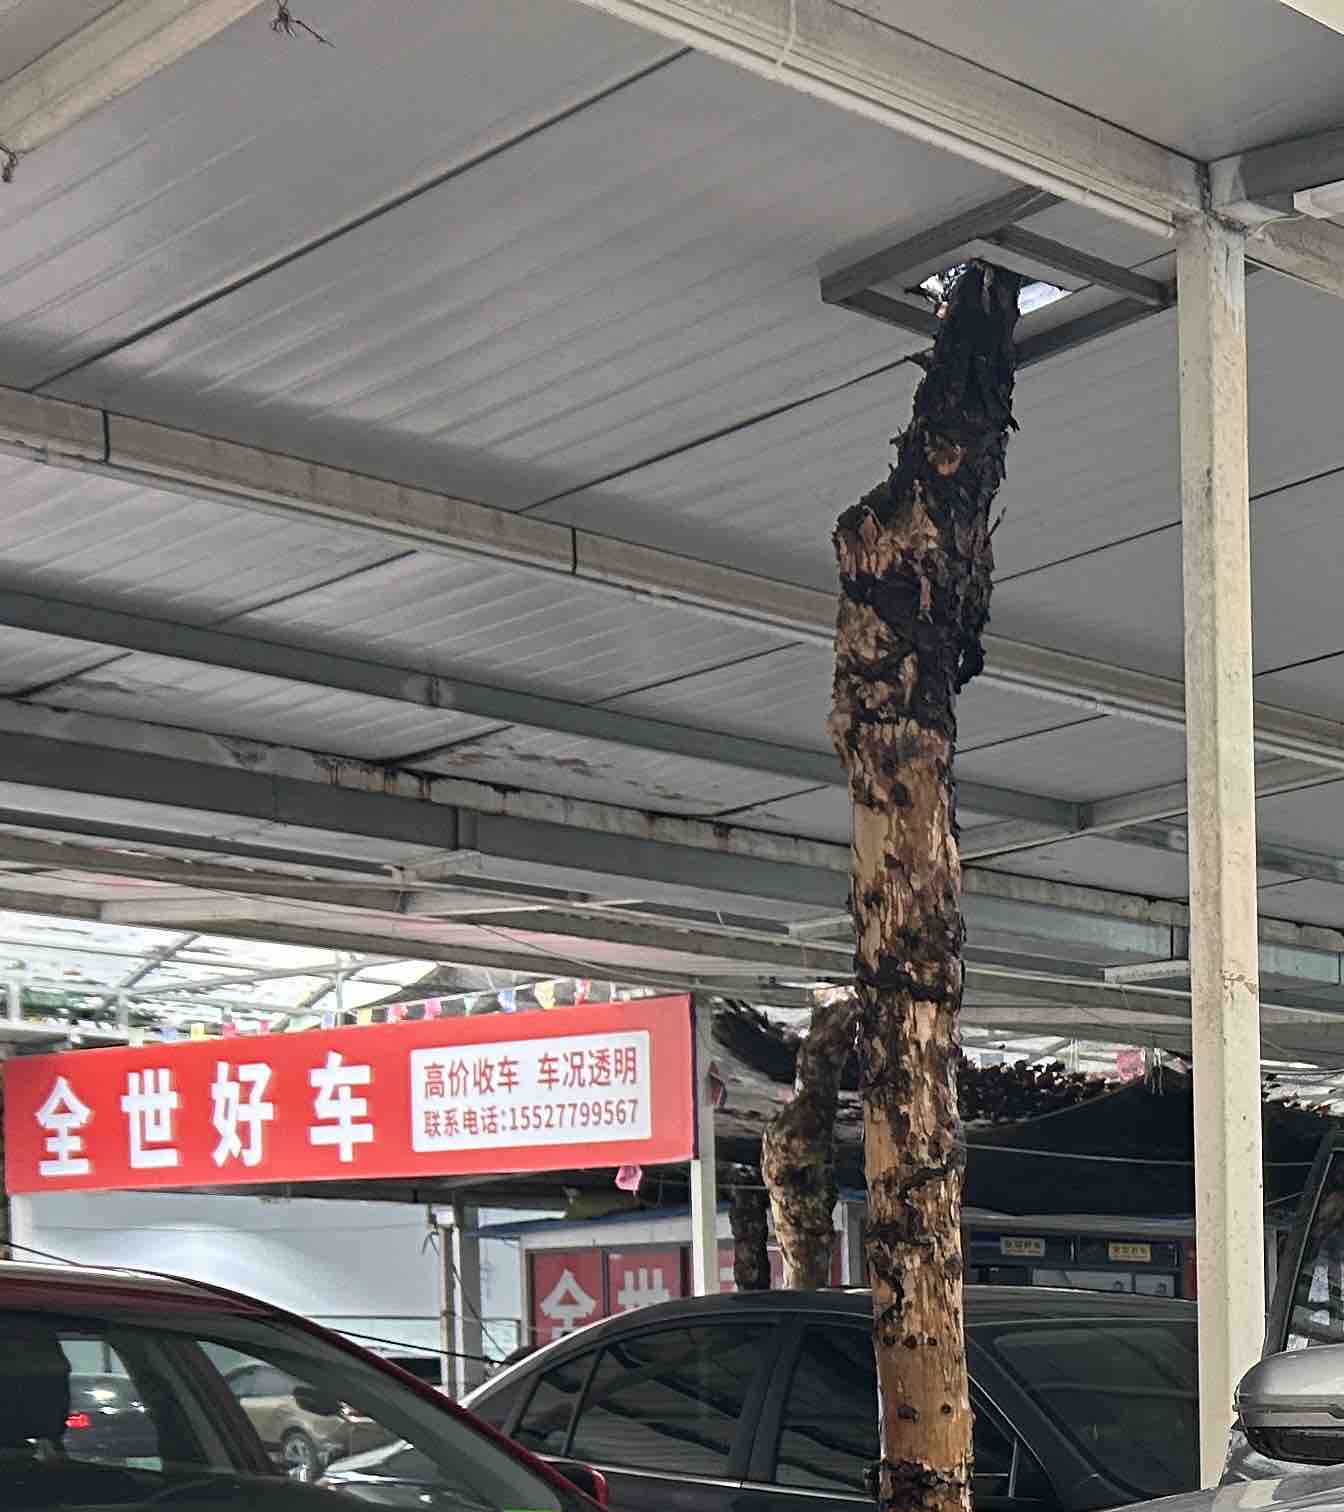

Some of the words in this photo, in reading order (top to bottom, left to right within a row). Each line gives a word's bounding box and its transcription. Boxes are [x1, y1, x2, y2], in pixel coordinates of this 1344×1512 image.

[424, 1056, 519, 1099] 高价收车
[537, 1046, 637, 1091] 车况透明
[34, 1051, 374, 1177] 全世好车
[424, 1099, 639, 1138] 联系电话:15527799567
